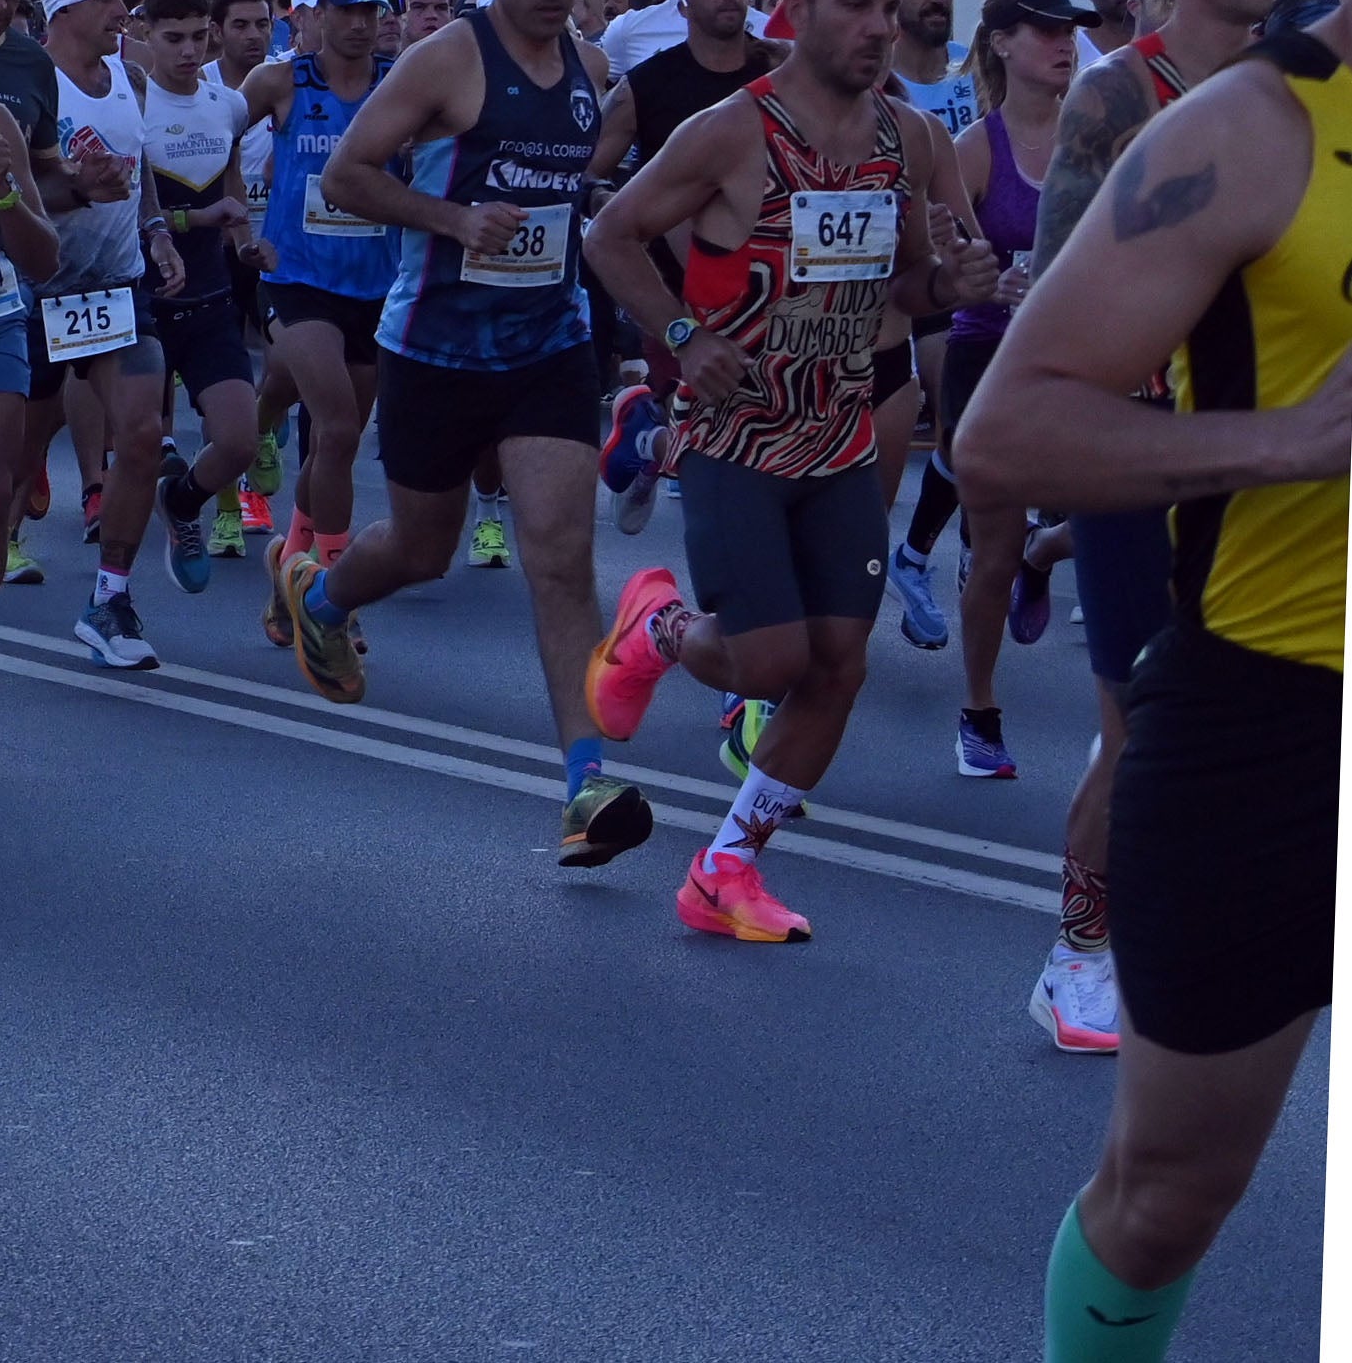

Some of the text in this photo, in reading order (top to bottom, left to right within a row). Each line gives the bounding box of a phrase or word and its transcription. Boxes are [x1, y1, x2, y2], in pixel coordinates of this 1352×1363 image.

[499, 139, 543, 157] TOD@S
[244, 183, 270, 202] 44
[503, 225, 545, 257] 38
[818, 211, 872, 247] 647
[64, 305, 111, 336] 215
